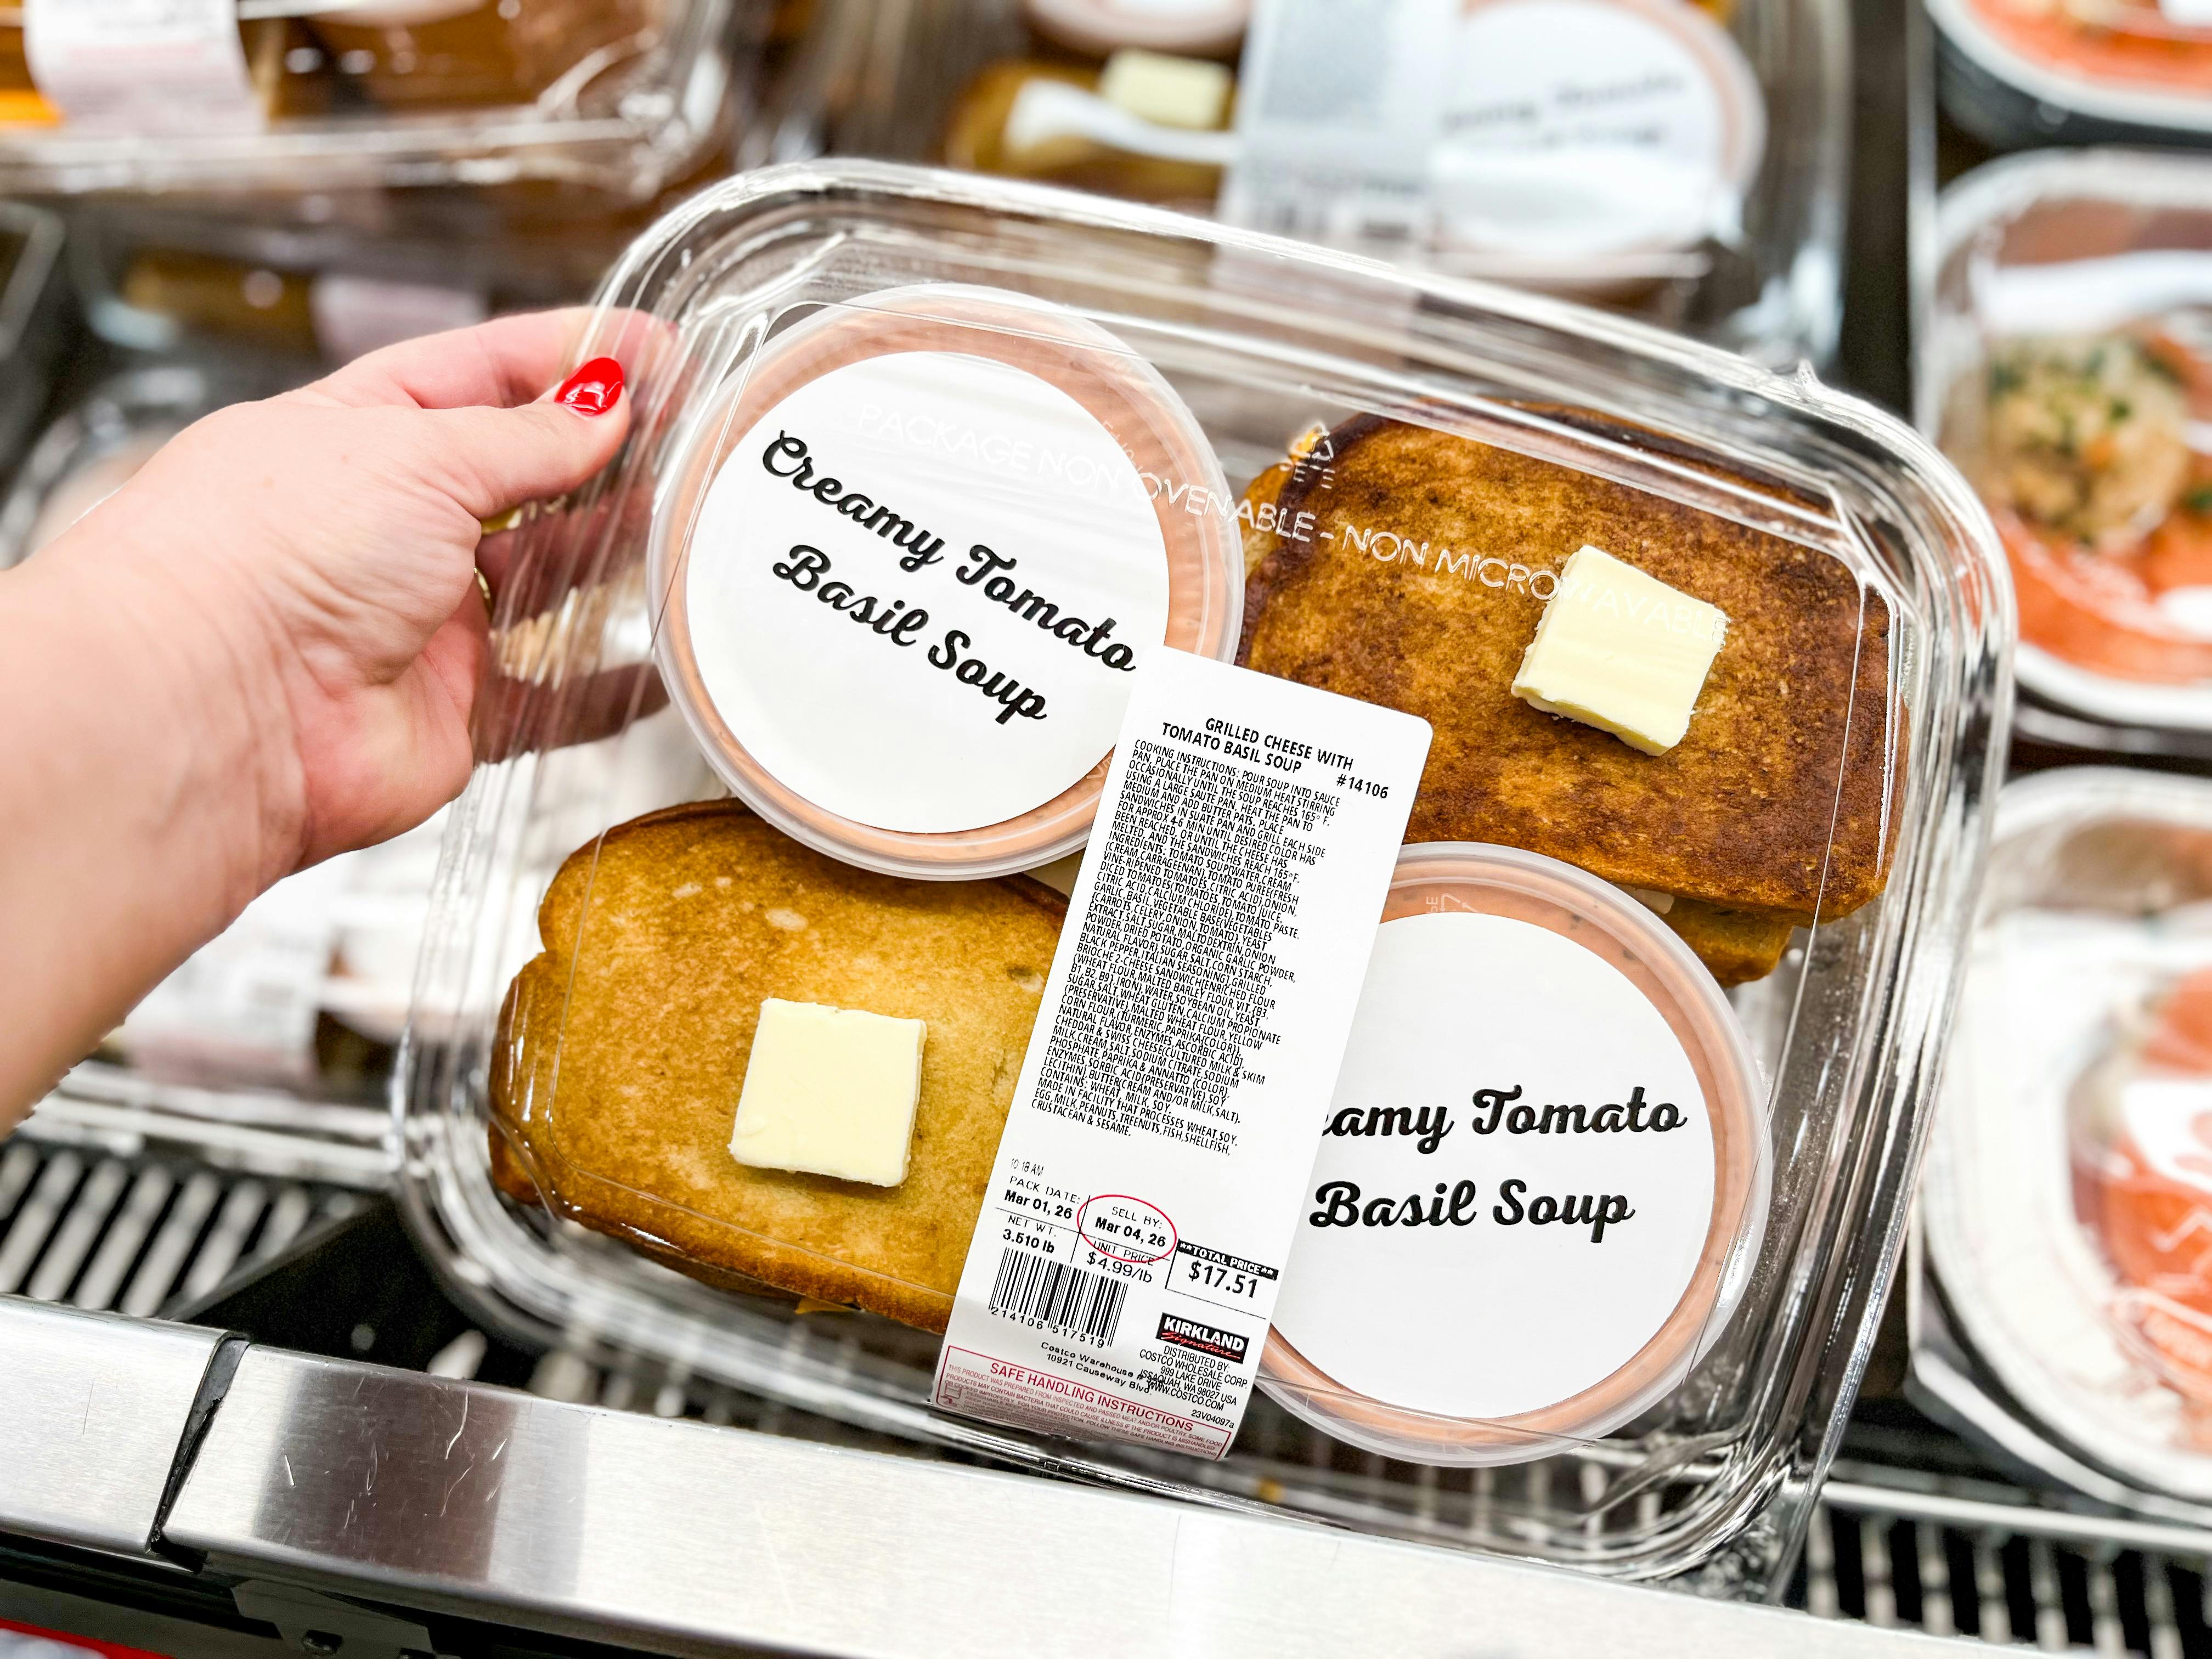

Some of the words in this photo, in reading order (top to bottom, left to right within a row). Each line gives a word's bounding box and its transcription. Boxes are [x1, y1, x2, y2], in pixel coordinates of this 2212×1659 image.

[857, 403, 1032, 473] PACKAGE
[1038, 448, 1124, 490] NON
[1133, 472, 1316, 543] OVENABLE
[1342, 526, 1429, 566] NON
[1435, 549, 1731, 652] MICROWAVABLE
[763, 431, 944, 572] Creamy
[956, 545, 1136, 672] Tomato
[772, 544, 928, 646] Basil
[928, 630, 1047, 724] Soup
[1162, 721, 1221, 751] TOMATO
[1223, 740, 1260, 763] BASIL
[1264, 752, 1302, 774] SOUP
[1205, 717, 1259, 743] GRILLED
[1263, 734, 1313, 759] CHEESE
[1317, 748, 1354, 771] WITH
[1128, 759, 1193, 786] OCCASIONALLY
[1193, 777, 1218, 794] UNTIL
[1221, 786, 1237, 799] THE
[1237, 791, 1261, 805] SOUP
[1261, 798, 1299, 817] REACHES
[1322, 815, 1330, 826] F.
[1134, 738, 1175, 759] COOKING
[1176, 751, 1240, 778] INSTRUCTIONS:
[1241, 769, 1265, 786] POUR
[1265, 776, 1289, 792] SOUP
[1290, 783, 1312, 798] INTO
[1312, 791, 1341, 807] SAUCE
[1154, 755, 1181, 772] PLACE
[1182, 763, 1199, 777] THE
[1199, 768, 1219, 783] PAN
[1219, 775, 1234, 787] ON
[1235, 778, 1273, 798] MEDIUM
[1273, 790, 1296, 805] HEAT
[1296, 797, 1336, 816] STIRRING
[1336, 773, 1389, 799] #14106
[1122, 779, 1160, 799] MEDIUM
[1159, 790, 1180, 804] AND
[1180, 797, 1200, 810] ADD
[1200, 802, 1232, 820] BUTTER
[1232, 811, 1255, 827] PATS.
[1258, 819, 1284, 835] PLACE
[1125, 769, 1153, 786] USING
[1153, 777, 1160, 788] A
[1162, 780, 1189, 796] LARGE
[1189, 788, 1216, 804] SAUTE
[1240, 802, 1263, 817] HEAT
[1264, 809, 1280, 823] THE
[1280, 814, 1301, 828] PAN
[1302, 820, 1313, 832] TO
[1114, 809, 1137, 825] BEEN
[1180, 828, 1193, 842] OR
[1193, 832, 1219, 849] UNTIL
[1221, 840, 1238, 854] THE
[1238, 846, 1269, 864] CHEESE
[1270, 855, 1288, 868] HAS
[1116, 799, 1135, 813] FOR
[1134, 805, 1170, 823] APPROX
[1185, 819, 1205, 834] MIN
[1205, 825, 1231, 842] UNTIL
[1233, 833, 1268, 851] DESIRED
[1268, 844, 1297, 861] COLOR
[1299, 852, 1316, 865] HAS
[1119, 789, 1175, 814] SANDWICHES
[1176, 806, 1188, 818] IN
[1188, 810, 1215, 826] SUATE
[1216, 817, 1235, 832] PAN
[1235, 823, 1256, 837] AND
[1256, 830, 1280, 845] GRILL
[1282, 837, 1306, 852] EACH
[1306, 844, 1326, 858] SIDE
[1108, 830, 1167, 855] INGREDIENTS:
[1169, 847, 1204, 866] TOMATO
[1147, 831, 1168, 844] AND
[1170, 836, 1186, 850] THE
[1186, 842, 1242, 866] SANDWICHES
[1243, 858, 1272, 875] REACH
[1037, 1077, 1064, 1093] MADE
[1064, 1085, 1076, 1097] IN
[1076, 1088, 1115, 1108] FACILITY
[1116, 1099, 1138, 1115] THAT
[1139, 1107, 1184, 1128] PROCESSES
[1040, 1066, 1088, 1089] CONTAINS:
[1152, 1099, 1171, 1114] SOY.
[1031, 1098, 1086, 1122] CRUSTACEAN
[1086, 1114, 1094, 1126] &
[1095, 1117, 1131, 1137] SESAME.
[1322, 1105, 1454, 1153] amy
[1471, 1085, 1688, 1135] Tomato
[1009, 1175, 1040, 1192] PACK
[1045, 1185, 1080, 1204] DATE:
[1030, 1163, 1044, 1177] AM
[1003, 1188, 1030, 1206] Mar
[1032, 1198, 1051, 1216] 01,
[1053, 1204, 1073, 1220] 26
[1007, 1214, 1028, 1228] NET
[1111, 1205, 1137, 1222] SELL
[1143, 1215, 1163, 1229] BY:
[1309, 1180, 1477, 1228] Basil
[1493, 1179, 1634, 1243] Soup
[1041, 1239, 1055, 1254] lb
[1094, 1216, 1121, 1234] Mar
[1122, 1224, 1144, 1244] 04,
[1147, 1232, 1166, 1247] 26
[1086, 1250, 1152, 1283] $4.99/lb
[1092, 1239, 1117, 1254] UNIT
[1122, 1249, 1156, 1266] PRICE
[1188, 1259, 1258, 1299] $17.51
[1160, 1328, 1241, 1359] Signature
[1163, 1316, 1244, 1351] KIRKLAND
[1040, 1341, 1076, 1358] Costco
[1079, 1352, 1133, 1378] Warehouse
[1046, 1353, 1073, 1367] 10921
[1075, 1362, 1127, 1387] Causeway
[1127, 1380, 1155, 1396] Blvd.
[1139, 1348, 1173, 1367] COSTCO
[1174, 1358, 1224, 1381] WHOLESALE
[1223, 1373, 1248, 1389] CORP.
[1159, 1365, 1175, 1377] 999
[1175, 1369, 1197, 1384] LAKE
[1197, 1375, 1222, 1391] DRIVE
[1163, 1345, 1216, 1368] DISTRIBUTED
[1216, 1361, 1229, 1373] BY:
[990, 1362, 1025, 1382] SAFE
[1026, 1373, 1094, 1403] HANDLING
[1097, 1395, 1196, 1431] INSTRUCTIONS
[1146, 1380, 1224, 1411] WWW.COSTCO.COM
[1183, 1381, 1196, 1393] WA
[1196, 1386, 1220, 1400] 98027
[1220, 1392, 1237, 1406] USA
[1190, 1408, 1234, 1429] 23V04097a
